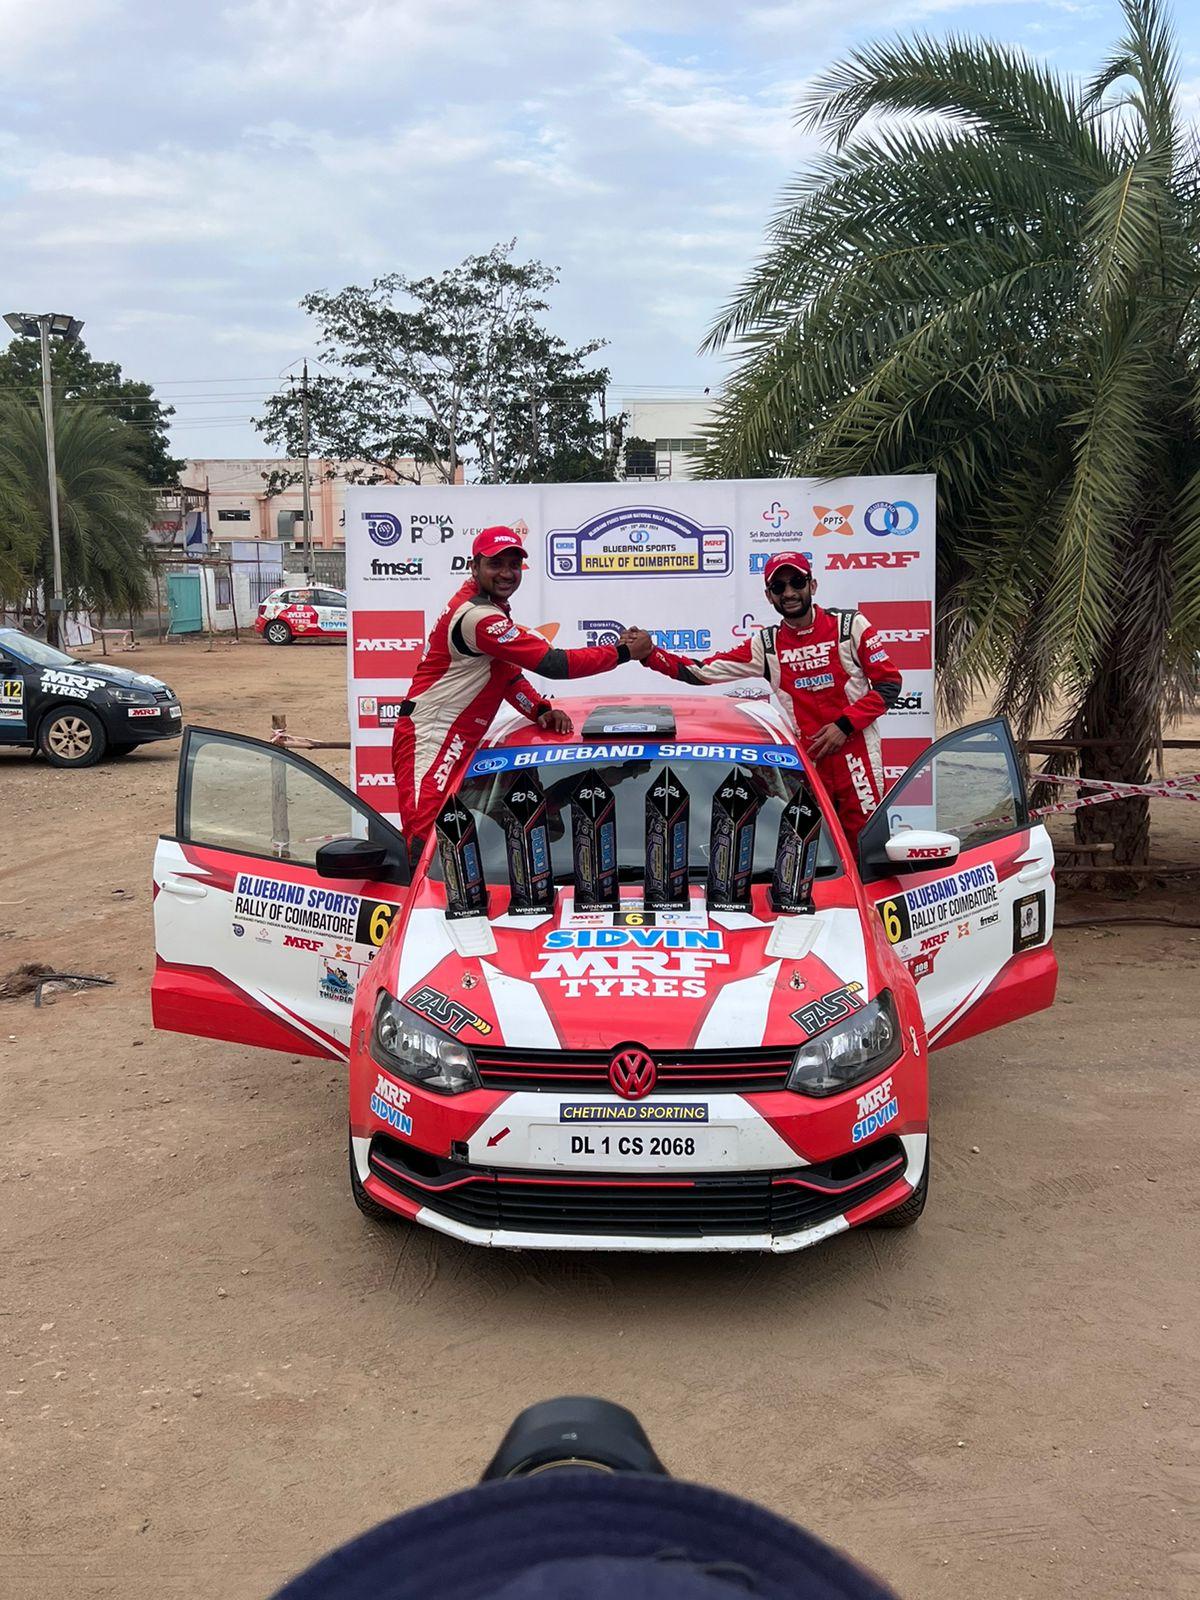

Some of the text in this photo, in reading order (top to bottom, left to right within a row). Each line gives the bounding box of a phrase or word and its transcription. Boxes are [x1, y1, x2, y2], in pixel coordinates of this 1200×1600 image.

[411, 515, 454, 524] POLKA
[823, 516, 844, 525] PPTS
[760, 530, 803, 538] Ramakrishna
[645, 544, 676, 552] SPORTS
[370, 558, 423, 575] fmsci
[585, 556, 695, 568] RALLY OF COIMBATORE
[824, 551, 920, 570] MRF
[355, 638, 423, 652] MRF
[780, 641, 836, 664] MRF
[789, 656, 830, 671] TYRES
[4, 681, 21, 697] 12
[40, 668, 106, 691] MRF
[795, 673, 834, 689] SIDVIN
[41, 681, 89, 699] TYRES
[132, 708, 158, 716] MRF
[514, 745, 758, 766] BLUEBAND SPORTS
[845, 753, 877, 814] MRF
[906, 846, 951, 858] MRF
[238, 876, 359, 916] BLUEBAND SPORTS
[906, 865, 995, 911] BLUEBAND SPORTS
[235, 896, 355, 935] RALLY OF COIMBATORE
[911, 905, 936, 931] RALLY
[938, 902, 947, 921] OF
[949, 885, 997, 917] COIMBATORE
[369, 904, 391, 947] 6
[625, 913, 644, 926] 6
[883, 901, 901, 944] 6
[283, 934, 324, 952] MRF
[543, 929, 723, 949] SIDVIN
[920, 930, 949, 951] MRF
[530, 951, 730, 979] MRF
[914, 961, 929, 973] 108
[560, 979, 707, 997] TYRES
[407, 985, 478, 1033] FAST
[791, 987, 861, 1034] FAST
[375, 1073, 411, 1110] MRF
[856, 1077, 892, 1119] MRF
[371, 1092, 413, 1136] SIDVIN
[563, 1107, 705, 1119] CHETTINAD SPORTING
[852, 1096, 898, 1143] SIDVIN
[571, 1136, 695, 1155] DL 1 CS 2068
